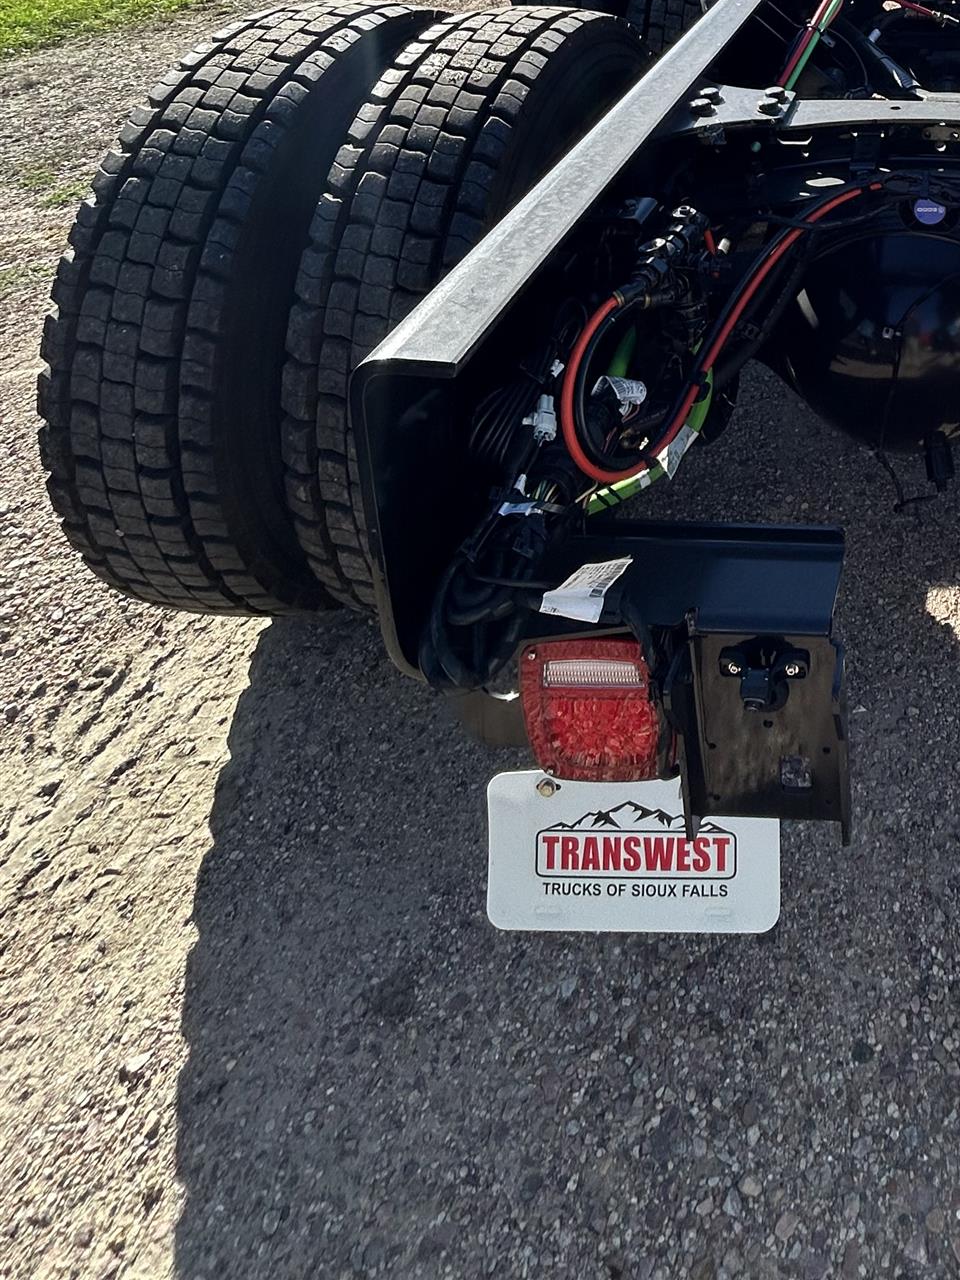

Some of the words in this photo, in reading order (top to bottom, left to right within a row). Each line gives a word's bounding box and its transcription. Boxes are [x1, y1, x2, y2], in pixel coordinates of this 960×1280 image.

[542, 836, 731, 872] TRANSWEST
[542, 882, 602, 897] TRUCKS
[606, 883, 627, 897] OF
[631, 883, 677, 898] SIOUX
[681, 884, 729, 898] FALLS
